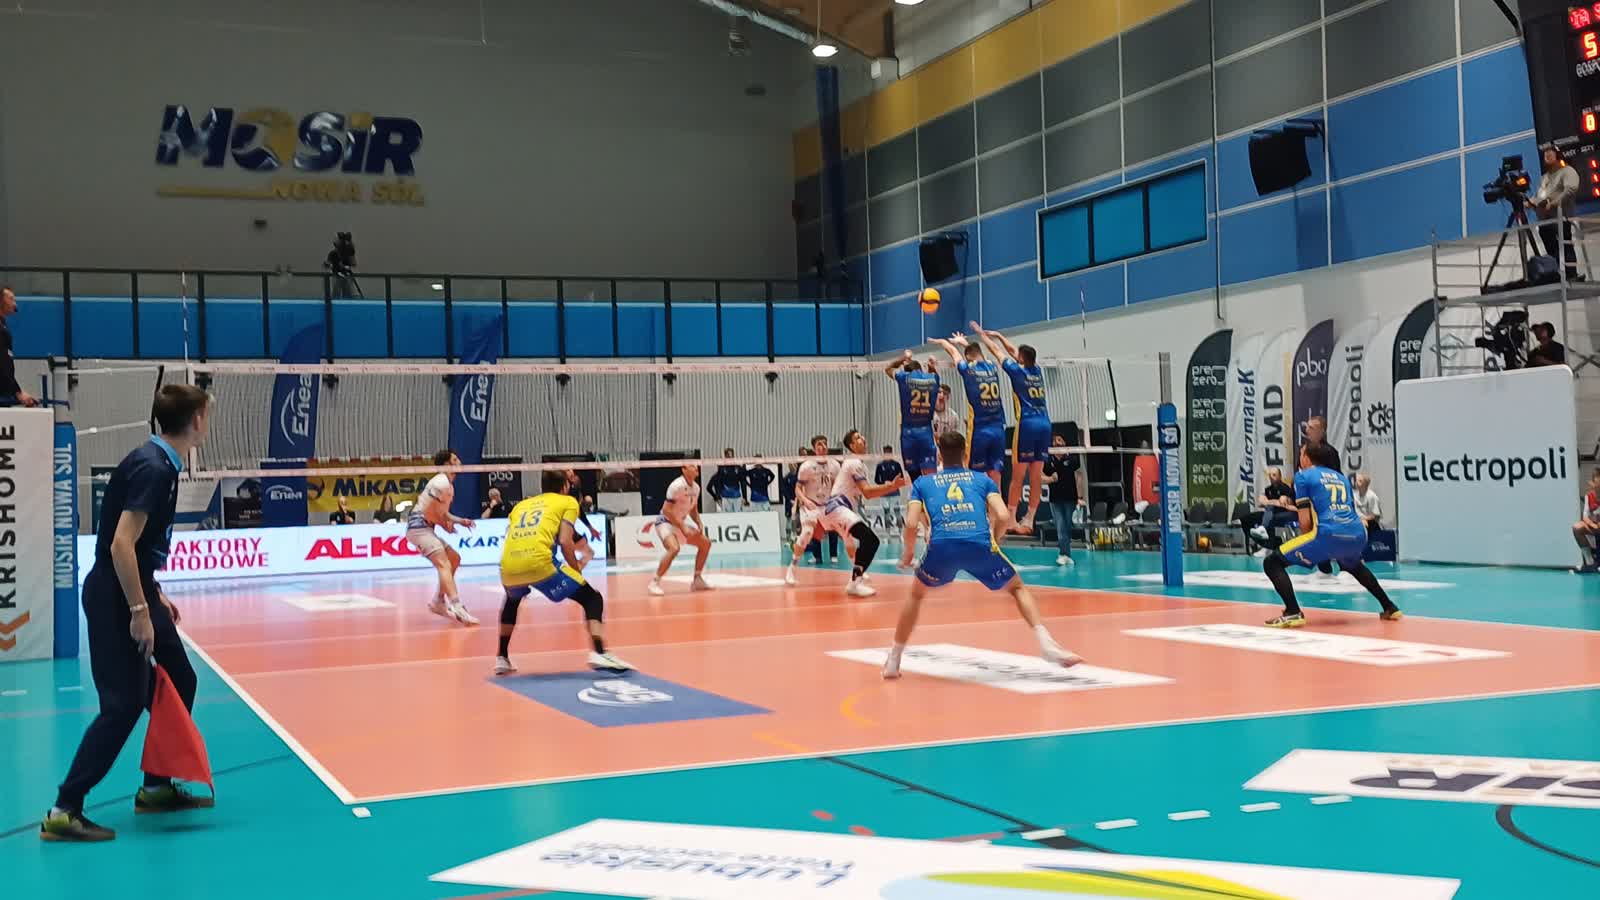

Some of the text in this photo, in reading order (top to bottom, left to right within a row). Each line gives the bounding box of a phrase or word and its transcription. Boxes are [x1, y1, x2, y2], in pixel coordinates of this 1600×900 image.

[1583, 32, 1598, 59] 5
[272, 181, 361, 202] NOWA
[1192, 365, 1212, 376] pre
[1192, 375, 1217, 386] zero
[911, 390, 930, 408] 21
[979, 382, 999, 400] 20
[1404, 446, 1567, 487] Electropoli
[946, 482, 964, 503] 4
[1325, 484, 1347, 504] 77
[515, 510, 542, 529] 13
[168, 537, 262, 555] AKTORY
[161, 552, 268, 572] RODOWE
